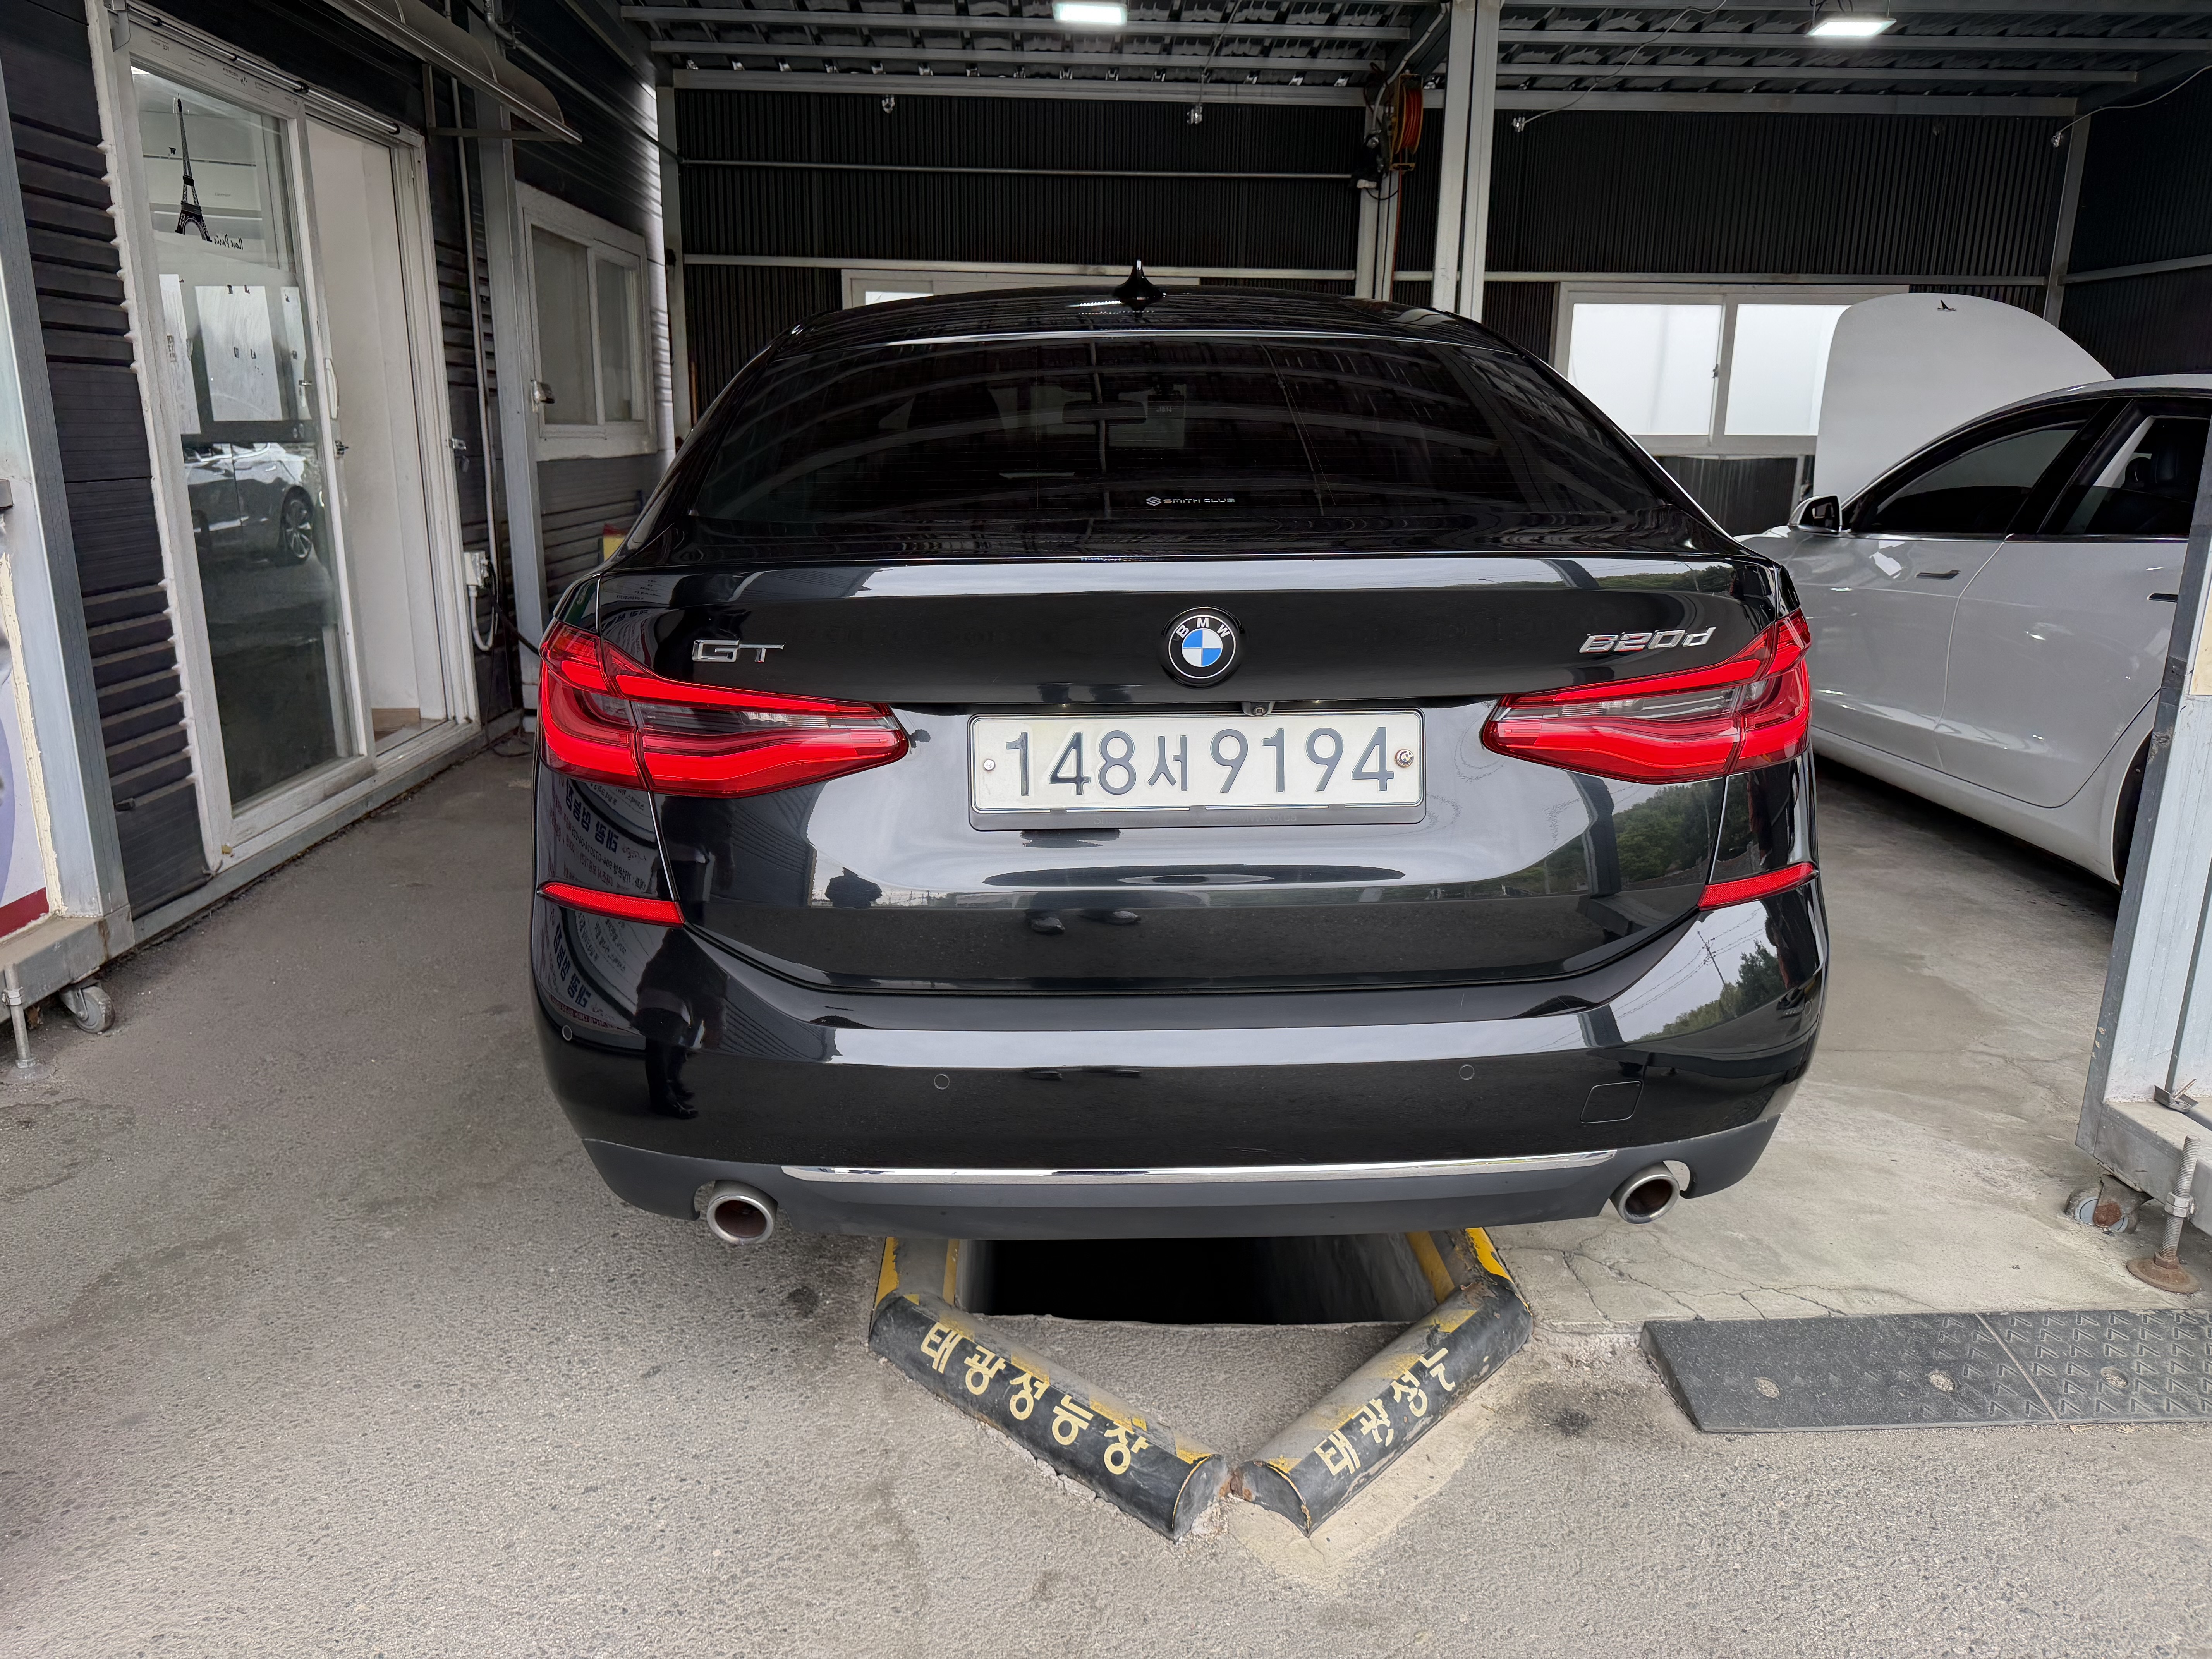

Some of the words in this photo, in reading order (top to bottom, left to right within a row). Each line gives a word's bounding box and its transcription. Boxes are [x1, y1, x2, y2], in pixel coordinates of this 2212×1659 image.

[1175, 617, 1231, 640] BMW
[1578, 627, 1716, 654] 620d
[692, 639, 785, 663] GT
[1264, 814, 1297, 823] Korea
[920, 1321, 1149, 1476] 태광성능장
